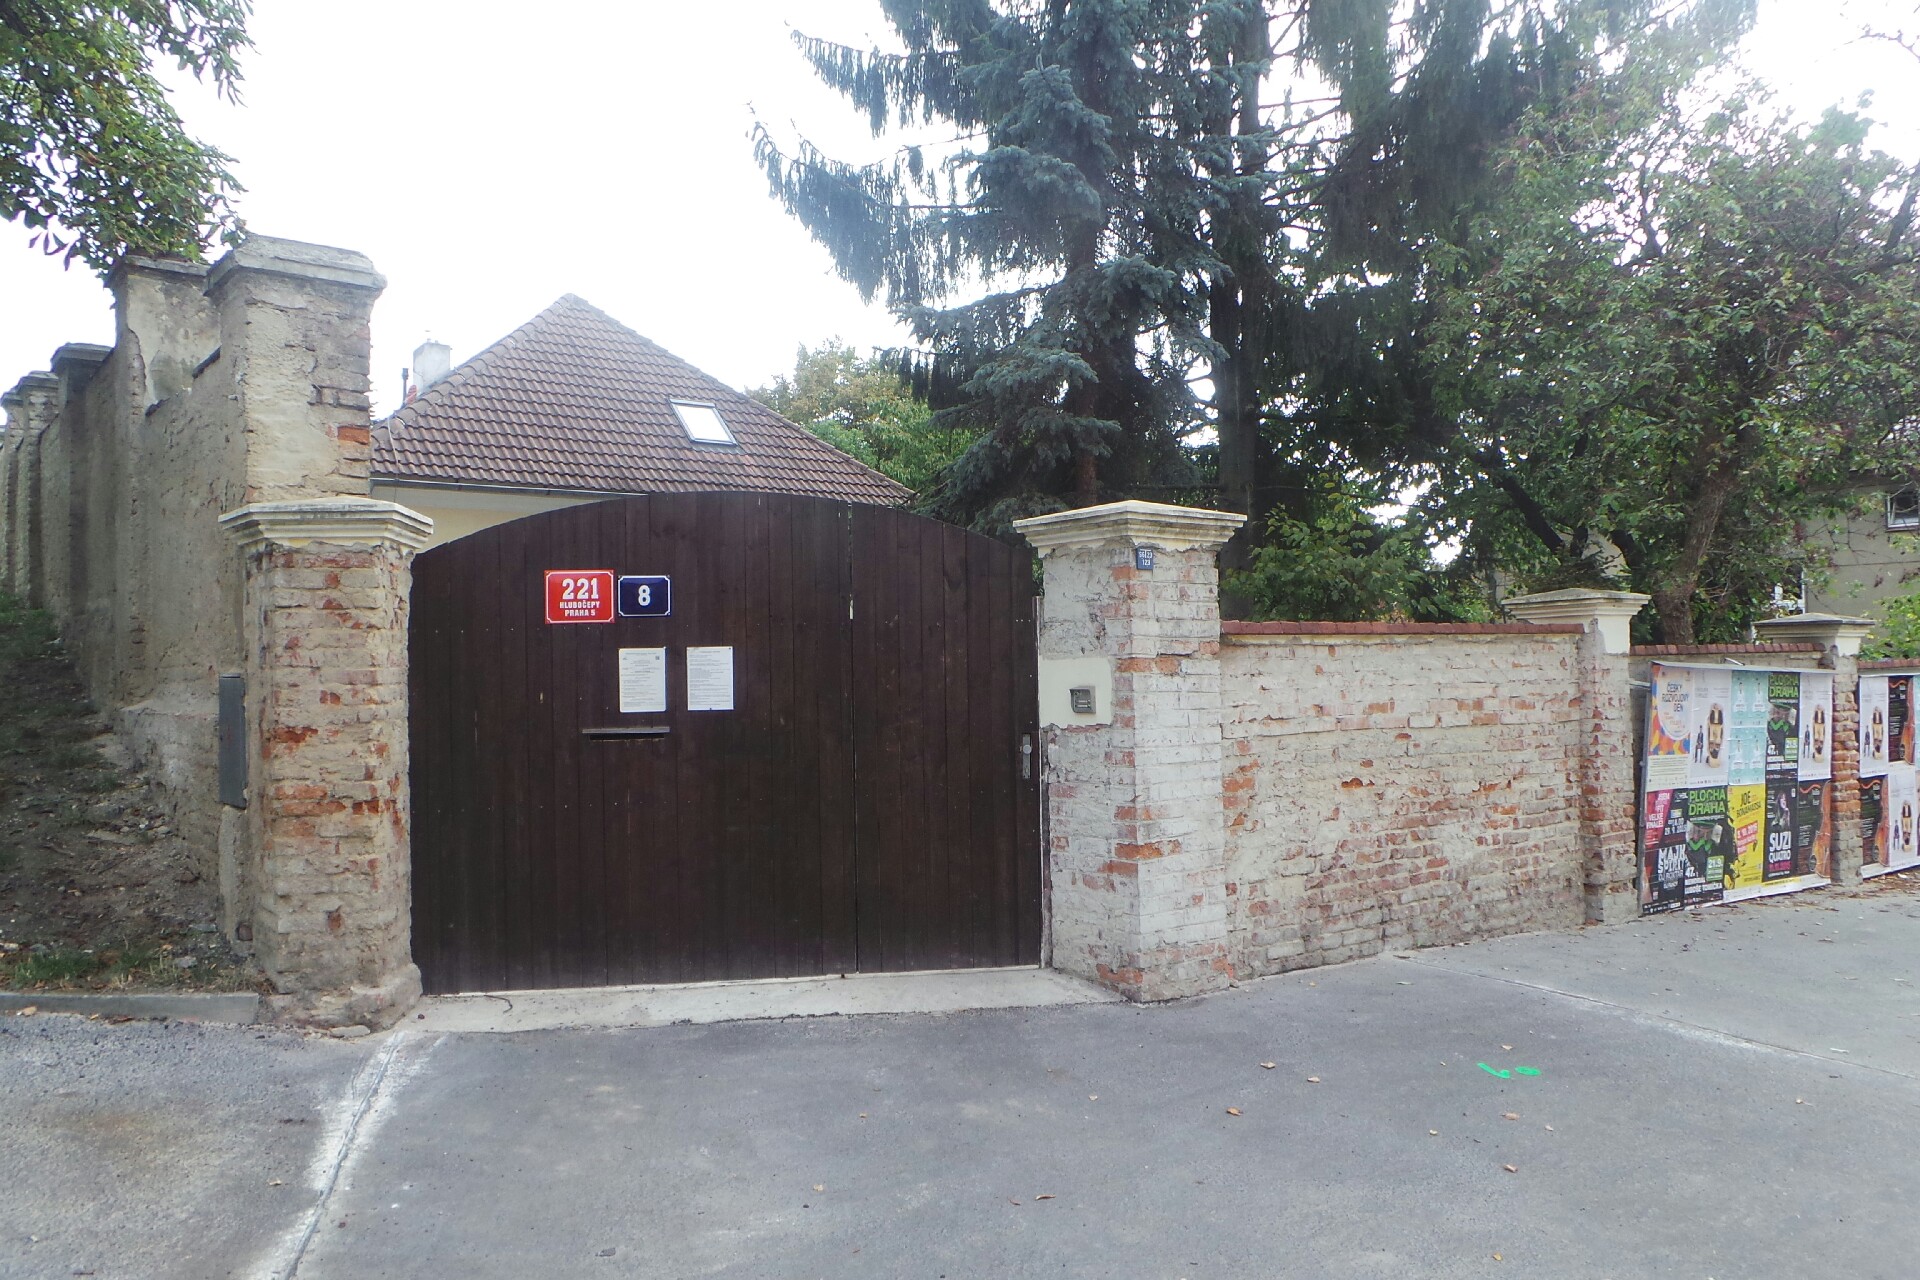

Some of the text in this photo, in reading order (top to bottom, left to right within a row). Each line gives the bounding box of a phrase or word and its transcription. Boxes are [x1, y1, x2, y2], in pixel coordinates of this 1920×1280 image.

[562, 577, 599, 600] 221
[638, 584, 651, 607] 8
[559, 600, 601, 609] HLUBOČEPY
[564, 609, 596, 617] PRAHA 5
[1769, 831, 1792, 852] SUZI
[1768, 850, 1791, 863] QUATRO
